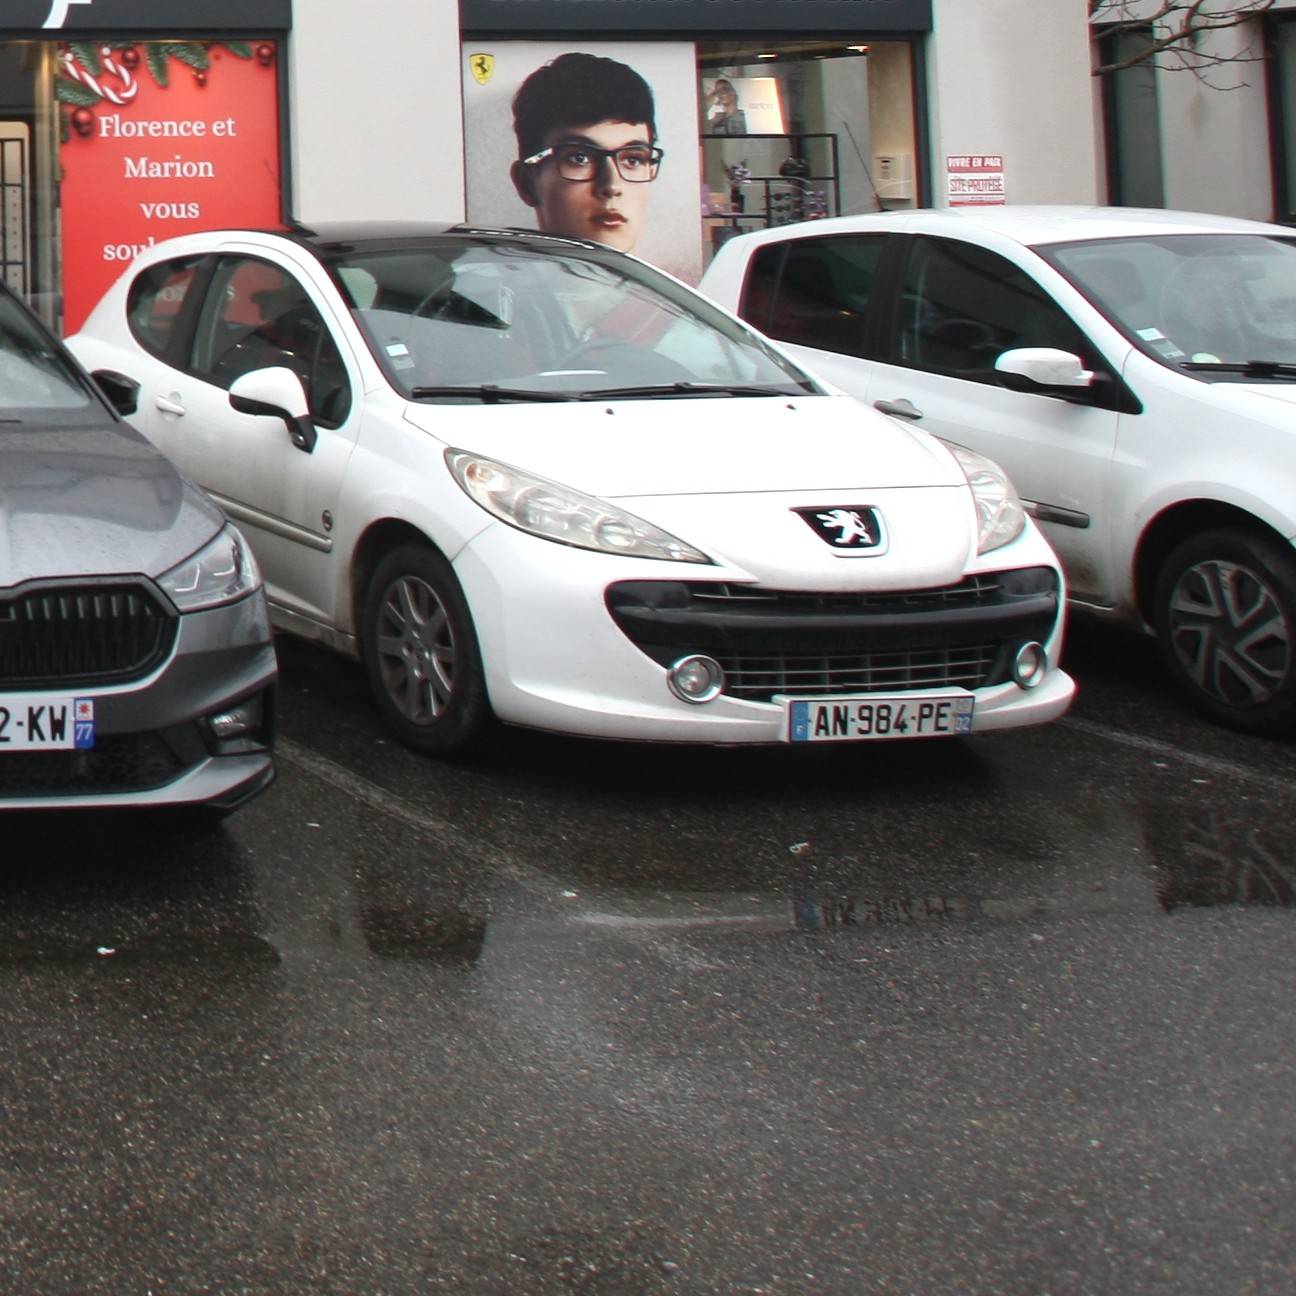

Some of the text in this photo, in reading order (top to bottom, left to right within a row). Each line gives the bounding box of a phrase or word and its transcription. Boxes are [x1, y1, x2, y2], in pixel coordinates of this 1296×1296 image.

[99, 114, 236, 137] Florence et
[124, 155, 214, 178] Marion
[140, 202, 200, 219] vous
[815, 702, 951, 736] AN-984-PE
[75, 723, 93, 741] 77
